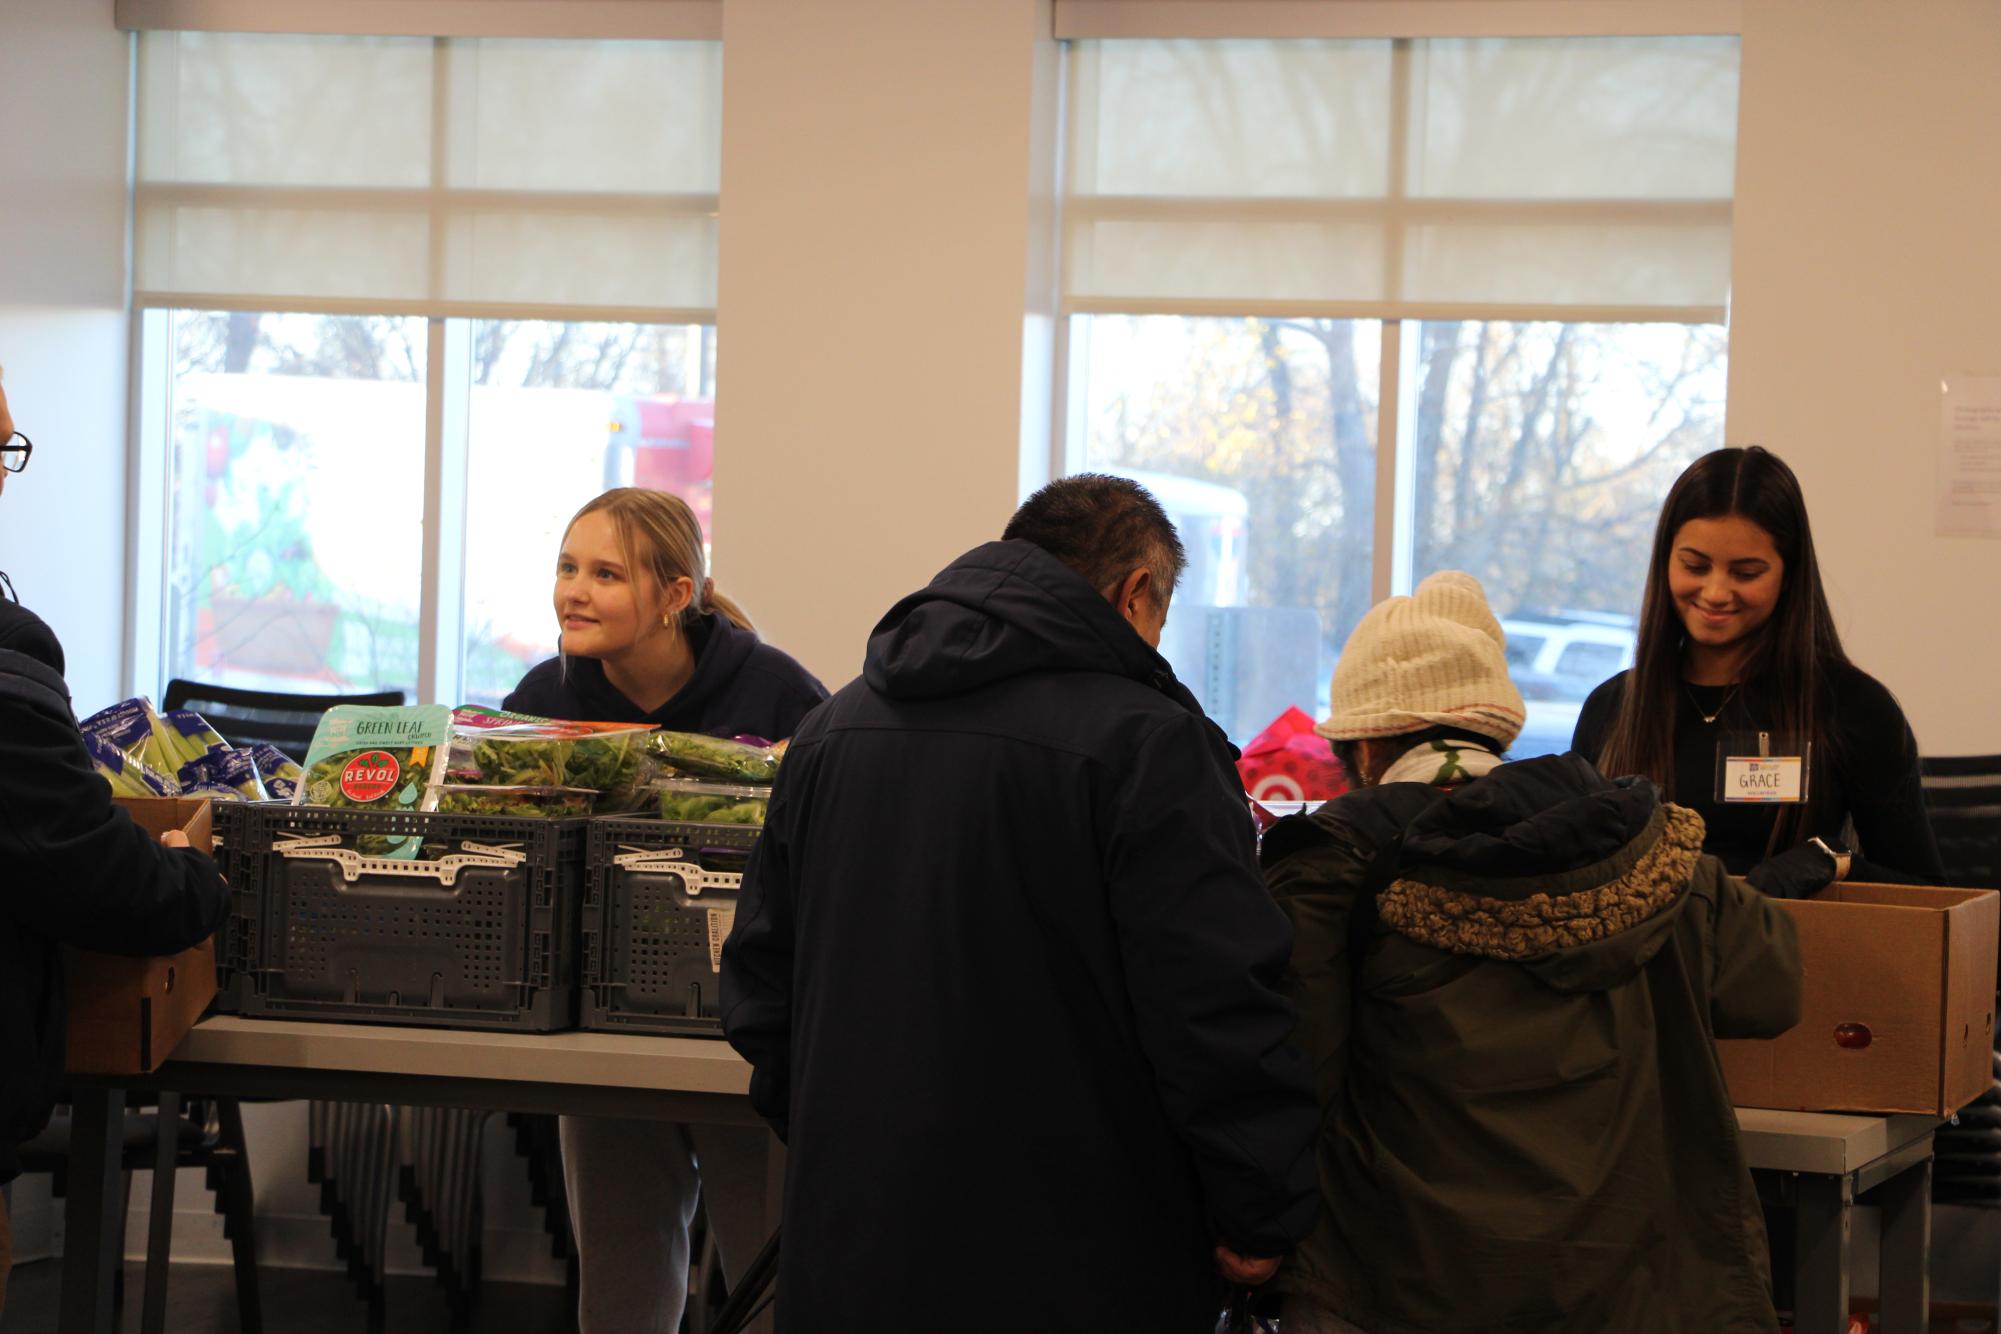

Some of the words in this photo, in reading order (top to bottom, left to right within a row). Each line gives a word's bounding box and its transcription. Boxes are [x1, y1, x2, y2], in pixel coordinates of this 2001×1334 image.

[356, 720, 393, 735] GREEN
[396, 720, 425, 735] LEAF
[344, 769, 394, 782] REVOL
[1740, 773, 1781, 788] GRACE
